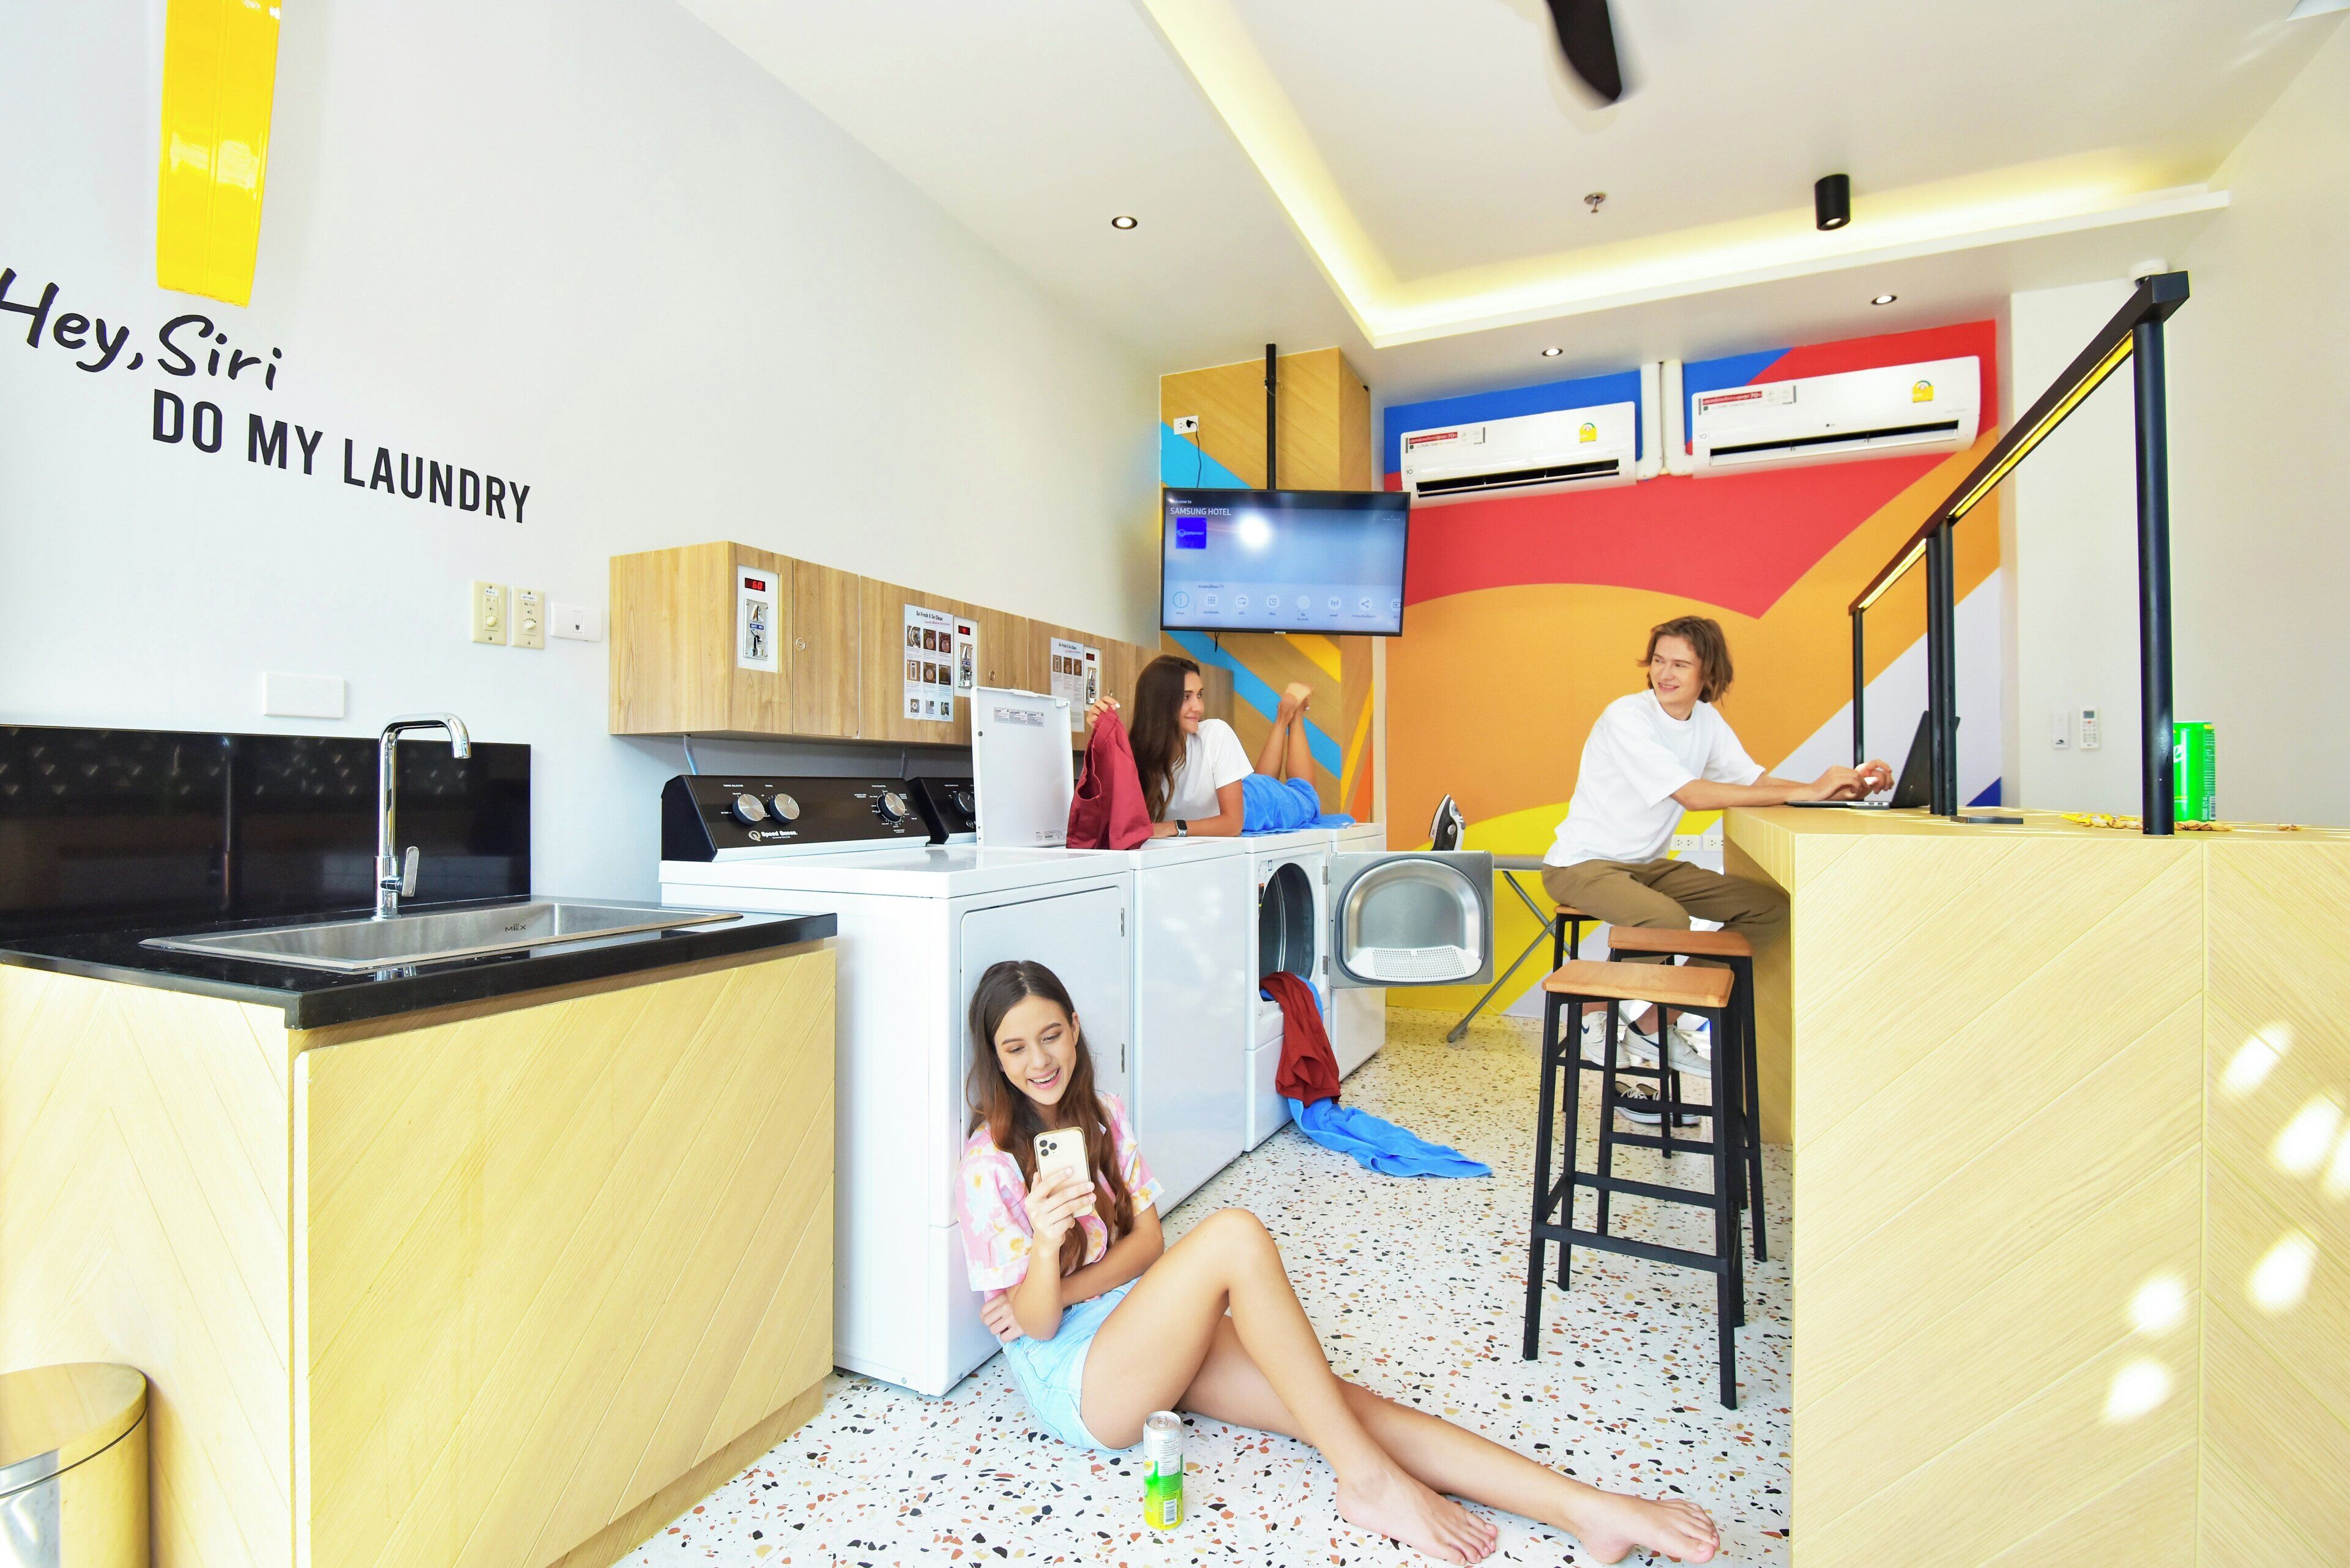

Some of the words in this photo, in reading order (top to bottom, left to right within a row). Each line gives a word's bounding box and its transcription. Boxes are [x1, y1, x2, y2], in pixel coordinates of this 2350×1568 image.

[0, 267, 143, 373] Hey,
[157, 314, 282, 391] Siri
[152, 389, 222, 454] DO
[248, 413, 323, 476] MY
[344, 438, 531, 524] LAUNDRY
